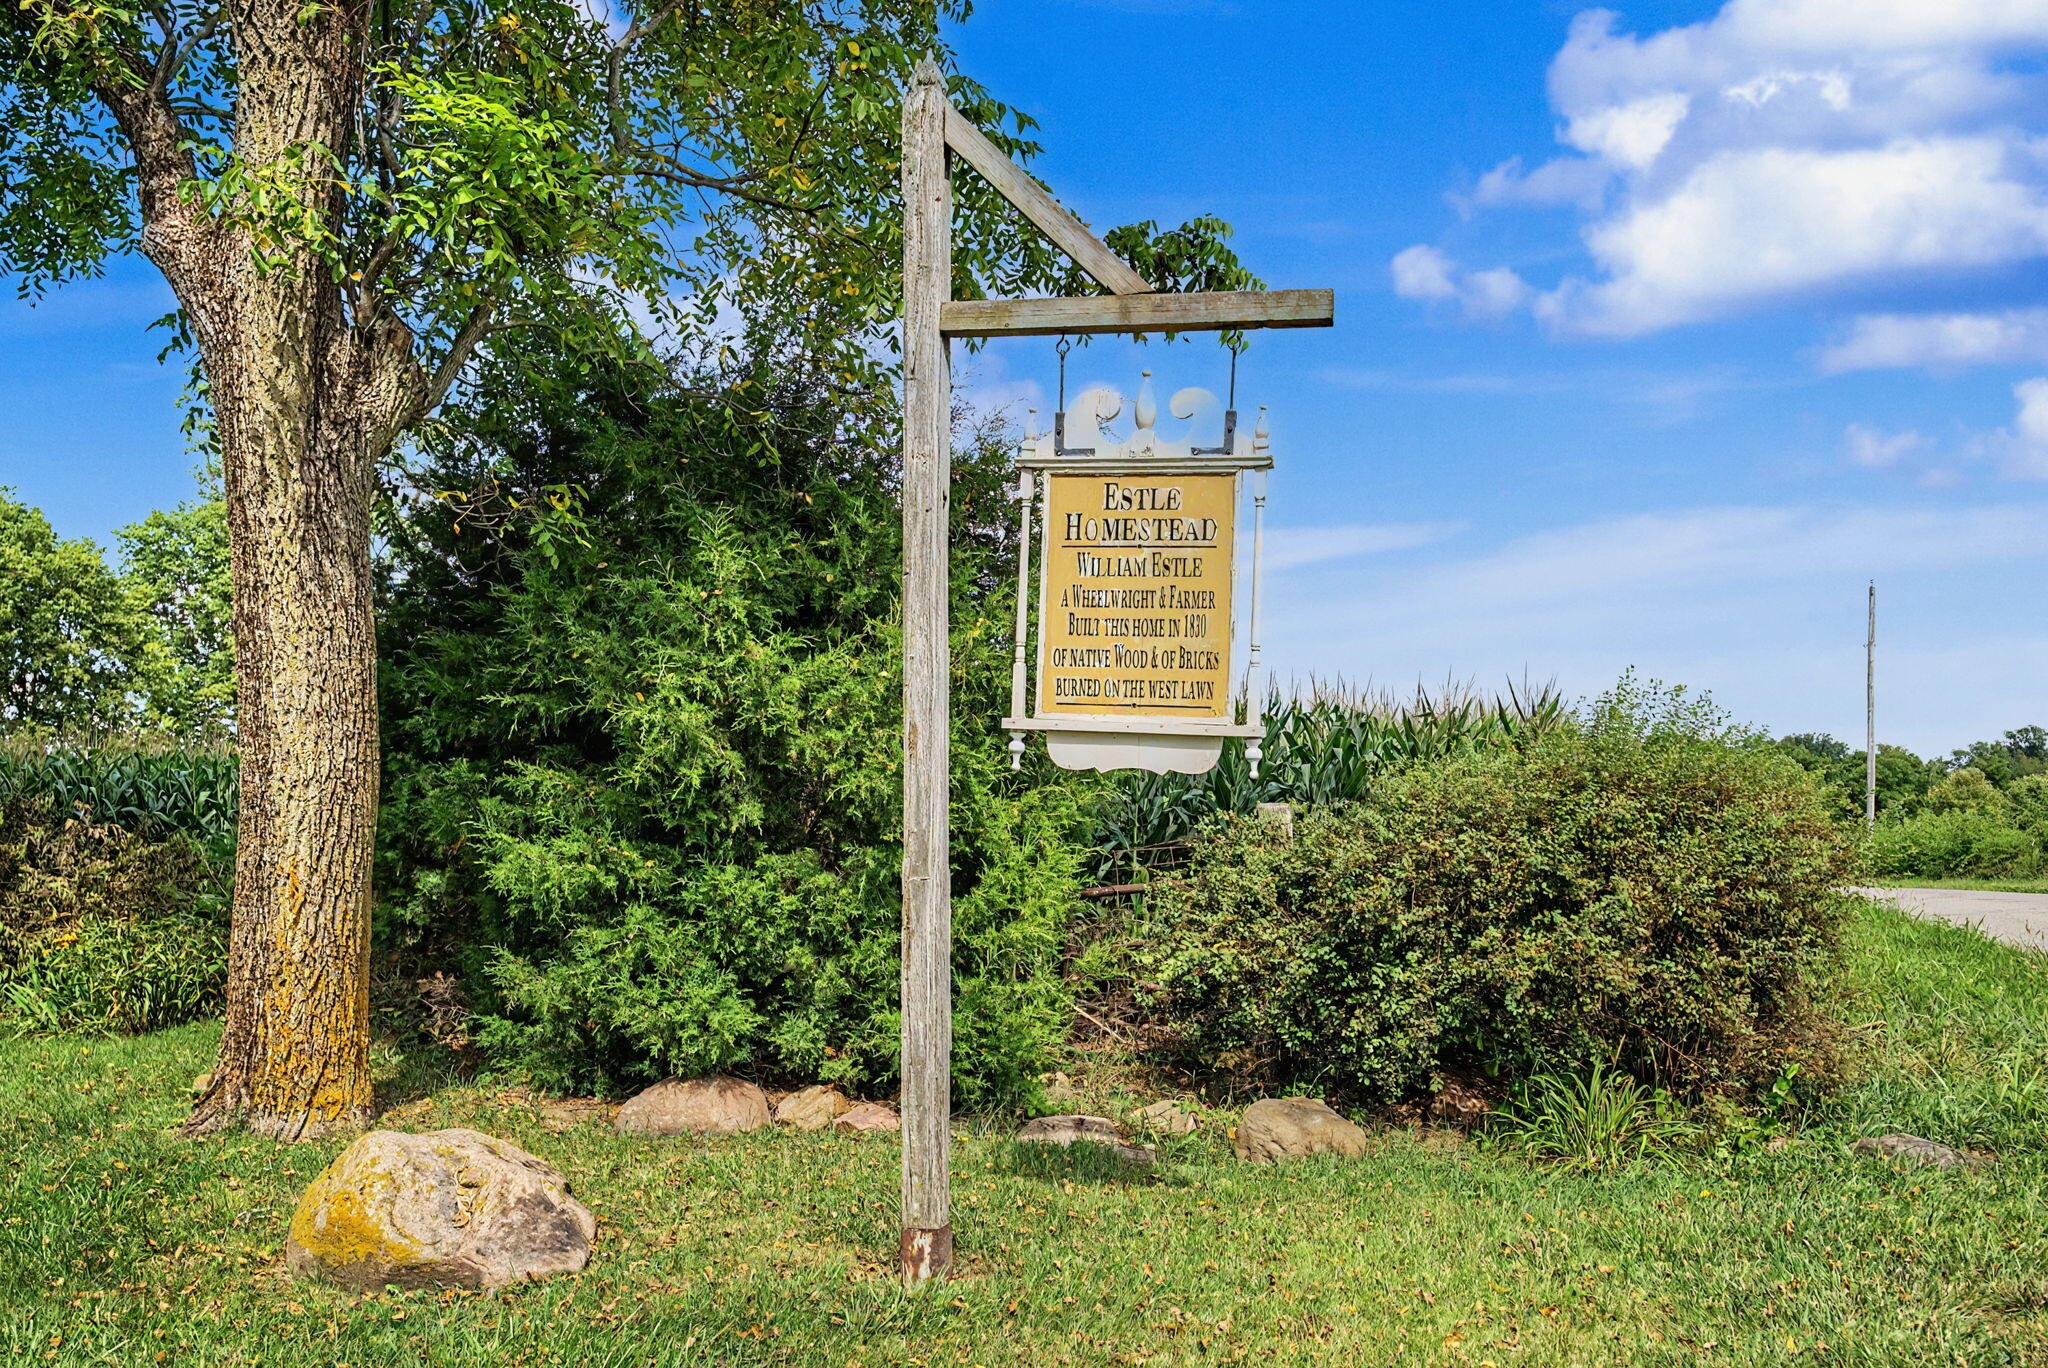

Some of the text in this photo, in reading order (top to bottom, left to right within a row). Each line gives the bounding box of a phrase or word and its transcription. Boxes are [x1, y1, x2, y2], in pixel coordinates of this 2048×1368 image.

[1103, 482, 1181, 511] ESTLE
[1064, 513, 1217, 541] HOMESTEAD
[1077, 552, 1203, 577] WILLIAM ESTLE
[1061, 584, 1216, 609] A WHEELWRIGHT & FARMER
[1068, 613, 1207, 638] BUILT THIS HOME IN 1830
[1053, 643, 1219, 670] OF NATIVE WOOD & OF BRICKS
[1056, 678, 1214, 700] BURNED ON THE WEST LAWN
